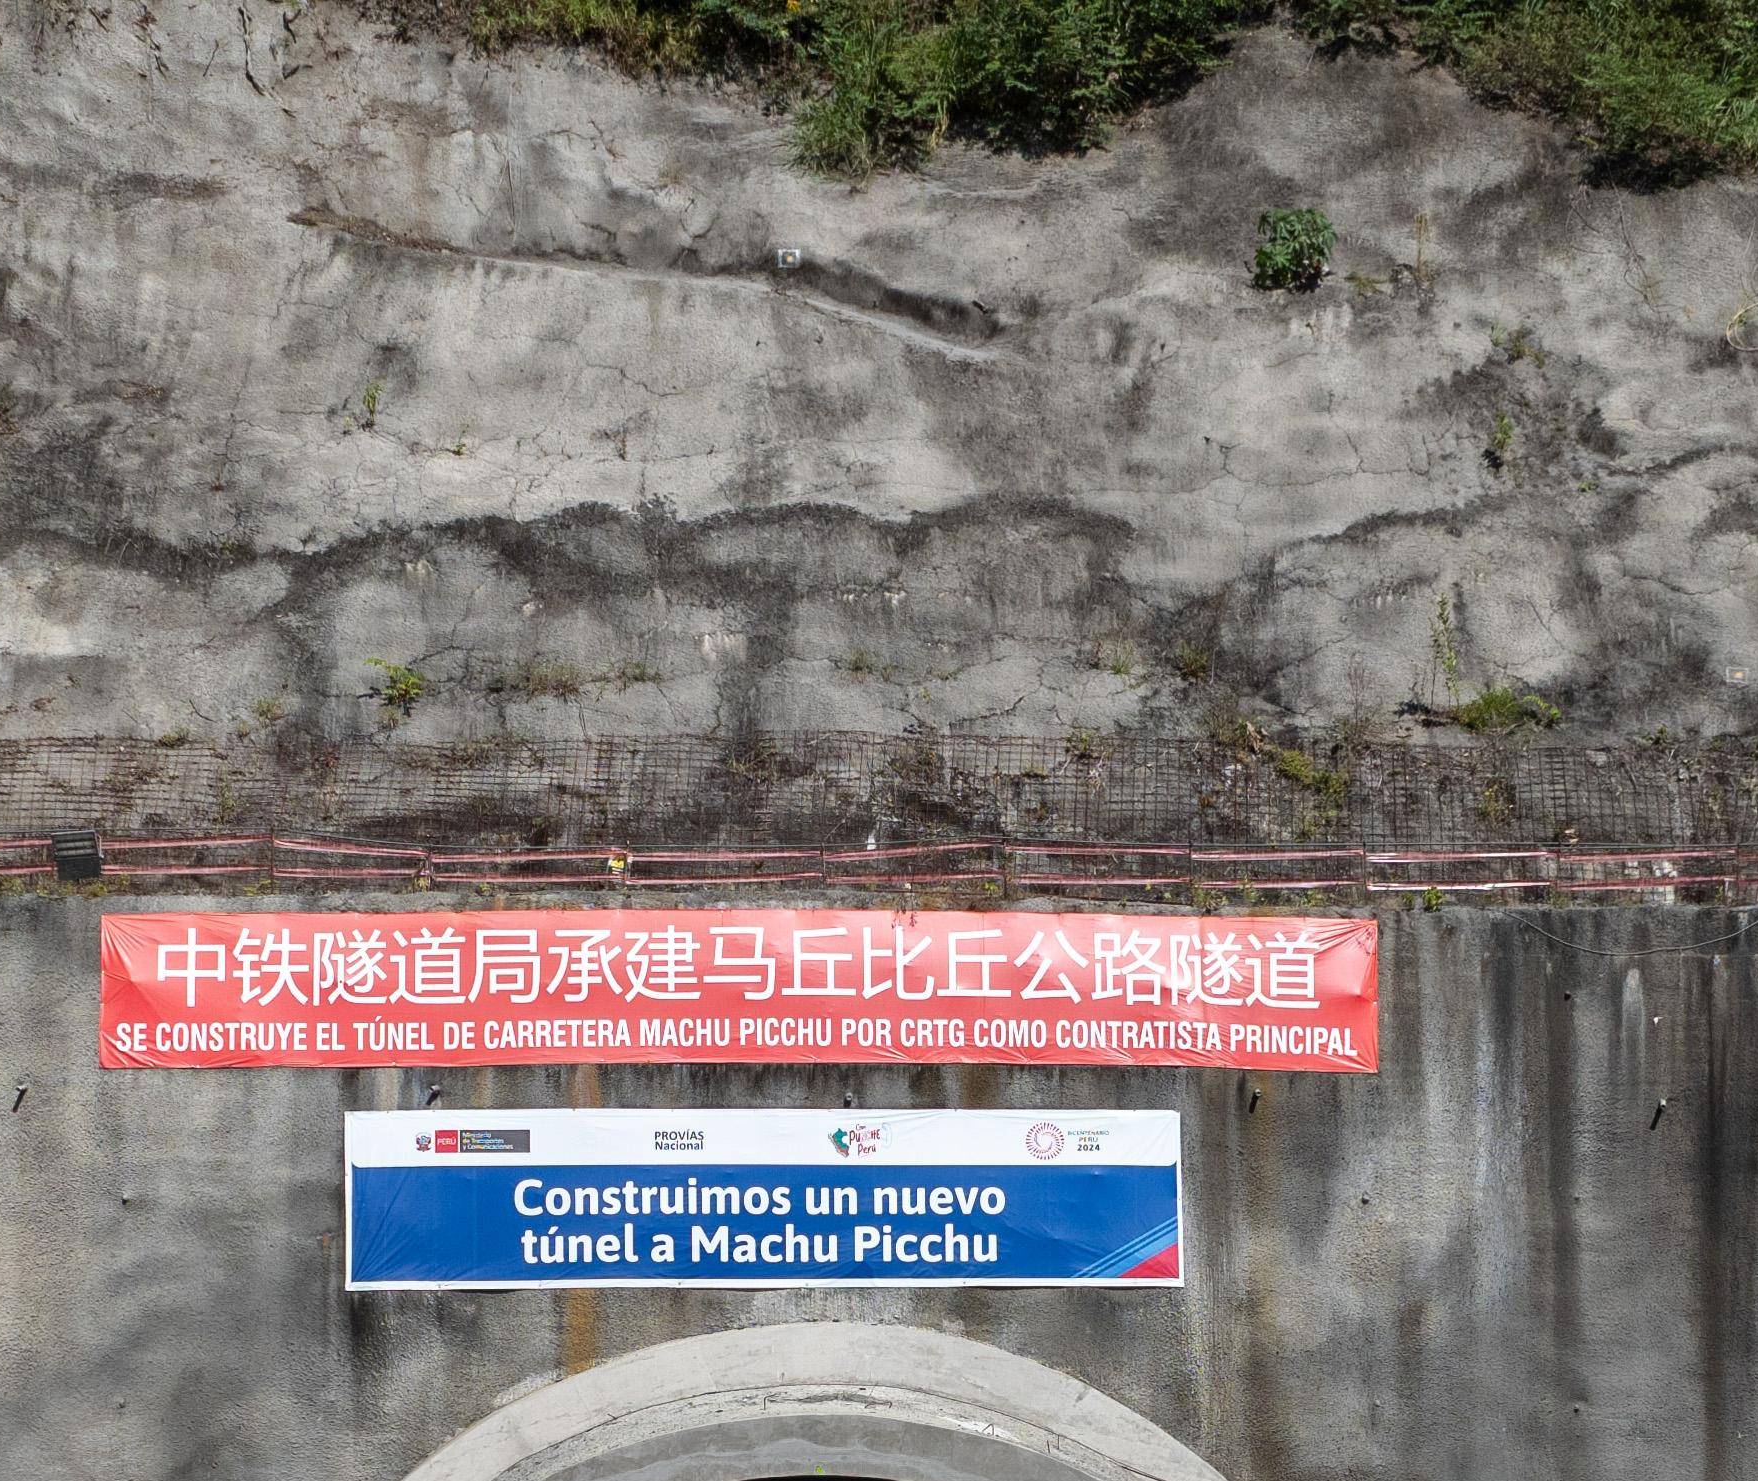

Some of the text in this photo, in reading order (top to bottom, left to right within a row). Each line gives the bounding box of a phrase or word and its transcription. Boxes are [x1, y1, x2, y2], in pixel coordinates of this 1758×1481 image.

[156, 924, 1322, 1009] 中铁隧道局承建马丘比丘公路隧道
[116, 1015, 1358, 1057] SE CONSTRUYE EL TÚNEL DE CARRETERA MACHU PICCHU POR CRTG COMO CONTRATISTA PRINCIPAL
[654, 1129, 704, 1141] PROVÍAS
[655, 1141, 704, 1151] Nacional
[513, 1178, 1006, 1217] Construimos un nuevo
[521, 1222, 998, 1264] túnel a Machu Picchu
